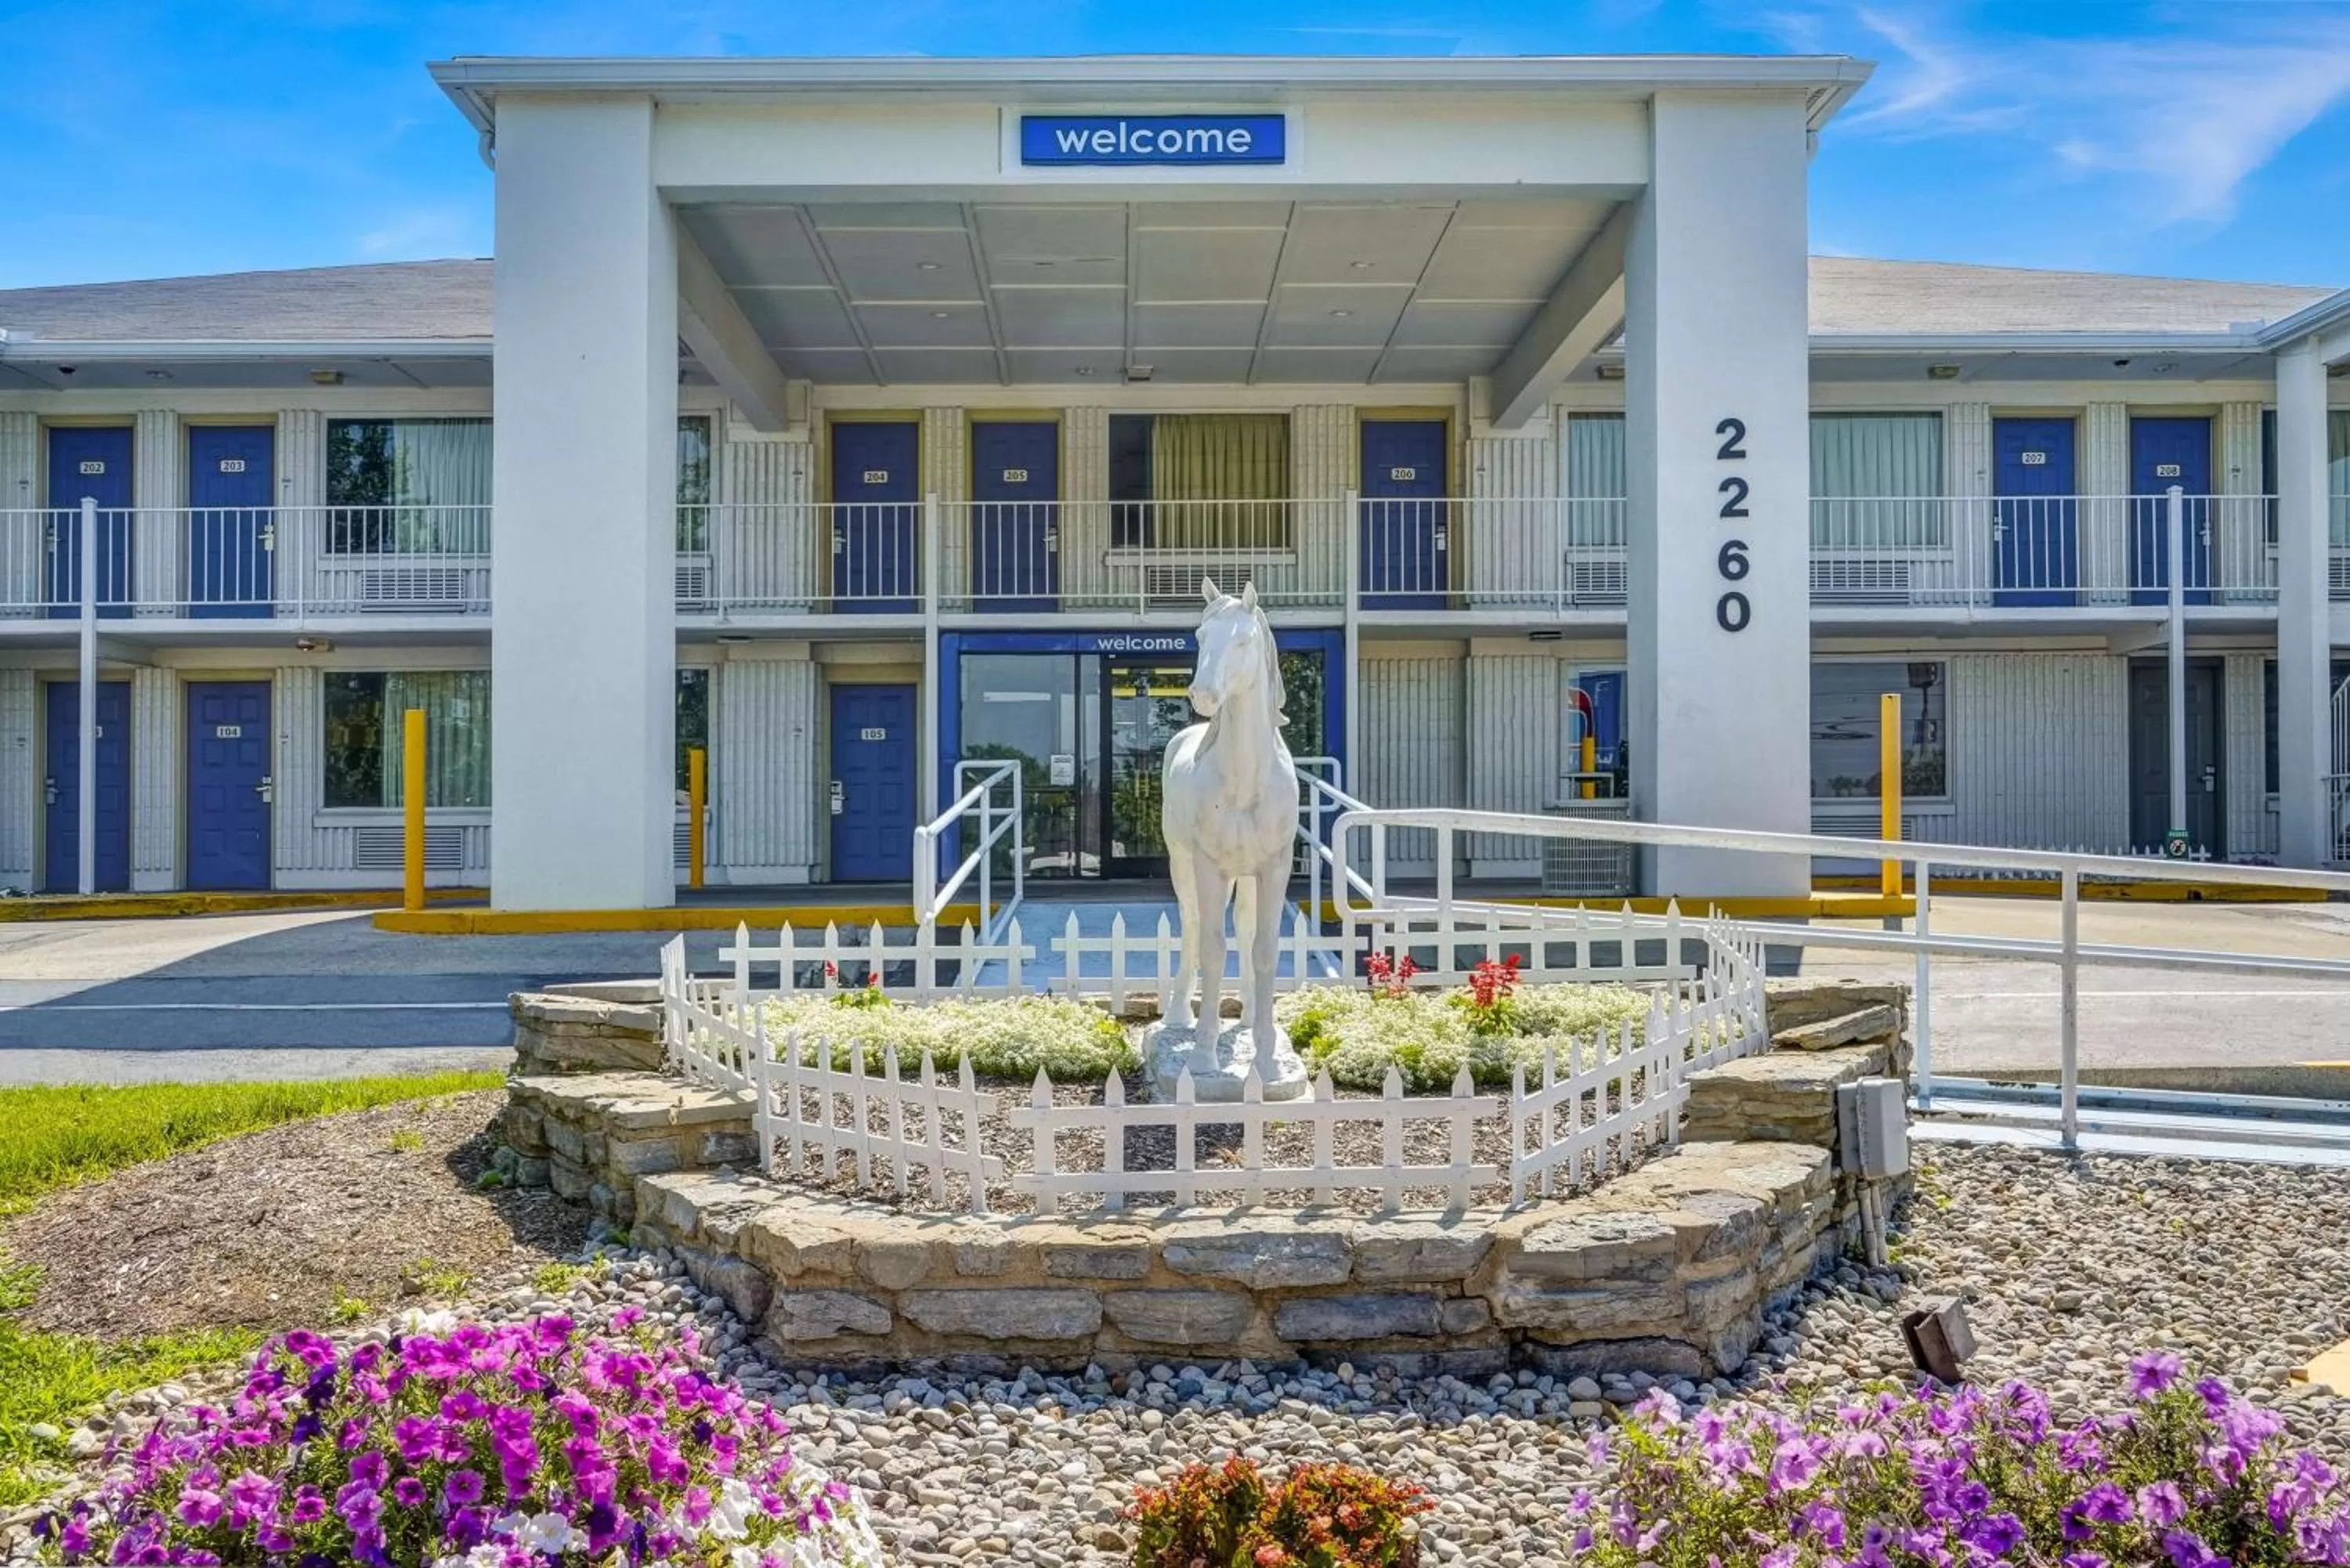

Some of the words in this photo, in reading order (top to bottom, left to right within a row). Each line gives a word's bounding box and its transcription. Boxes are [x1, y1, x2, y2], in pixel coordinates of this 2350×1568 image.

[1055, 121, 1253, 154] welcome
[2025, 453, 2043, 464] 207
[82, 463, 102, 473] 202
[223, 461, 242, 471] 203
[1394, 469, 1412, 479] 206
[1715, 417, 1752, 633] 2260
[1097, 634, 1187, 650] welcome
[219, 728, 237, 736] 104
[864, 729, 883, 739] 105
